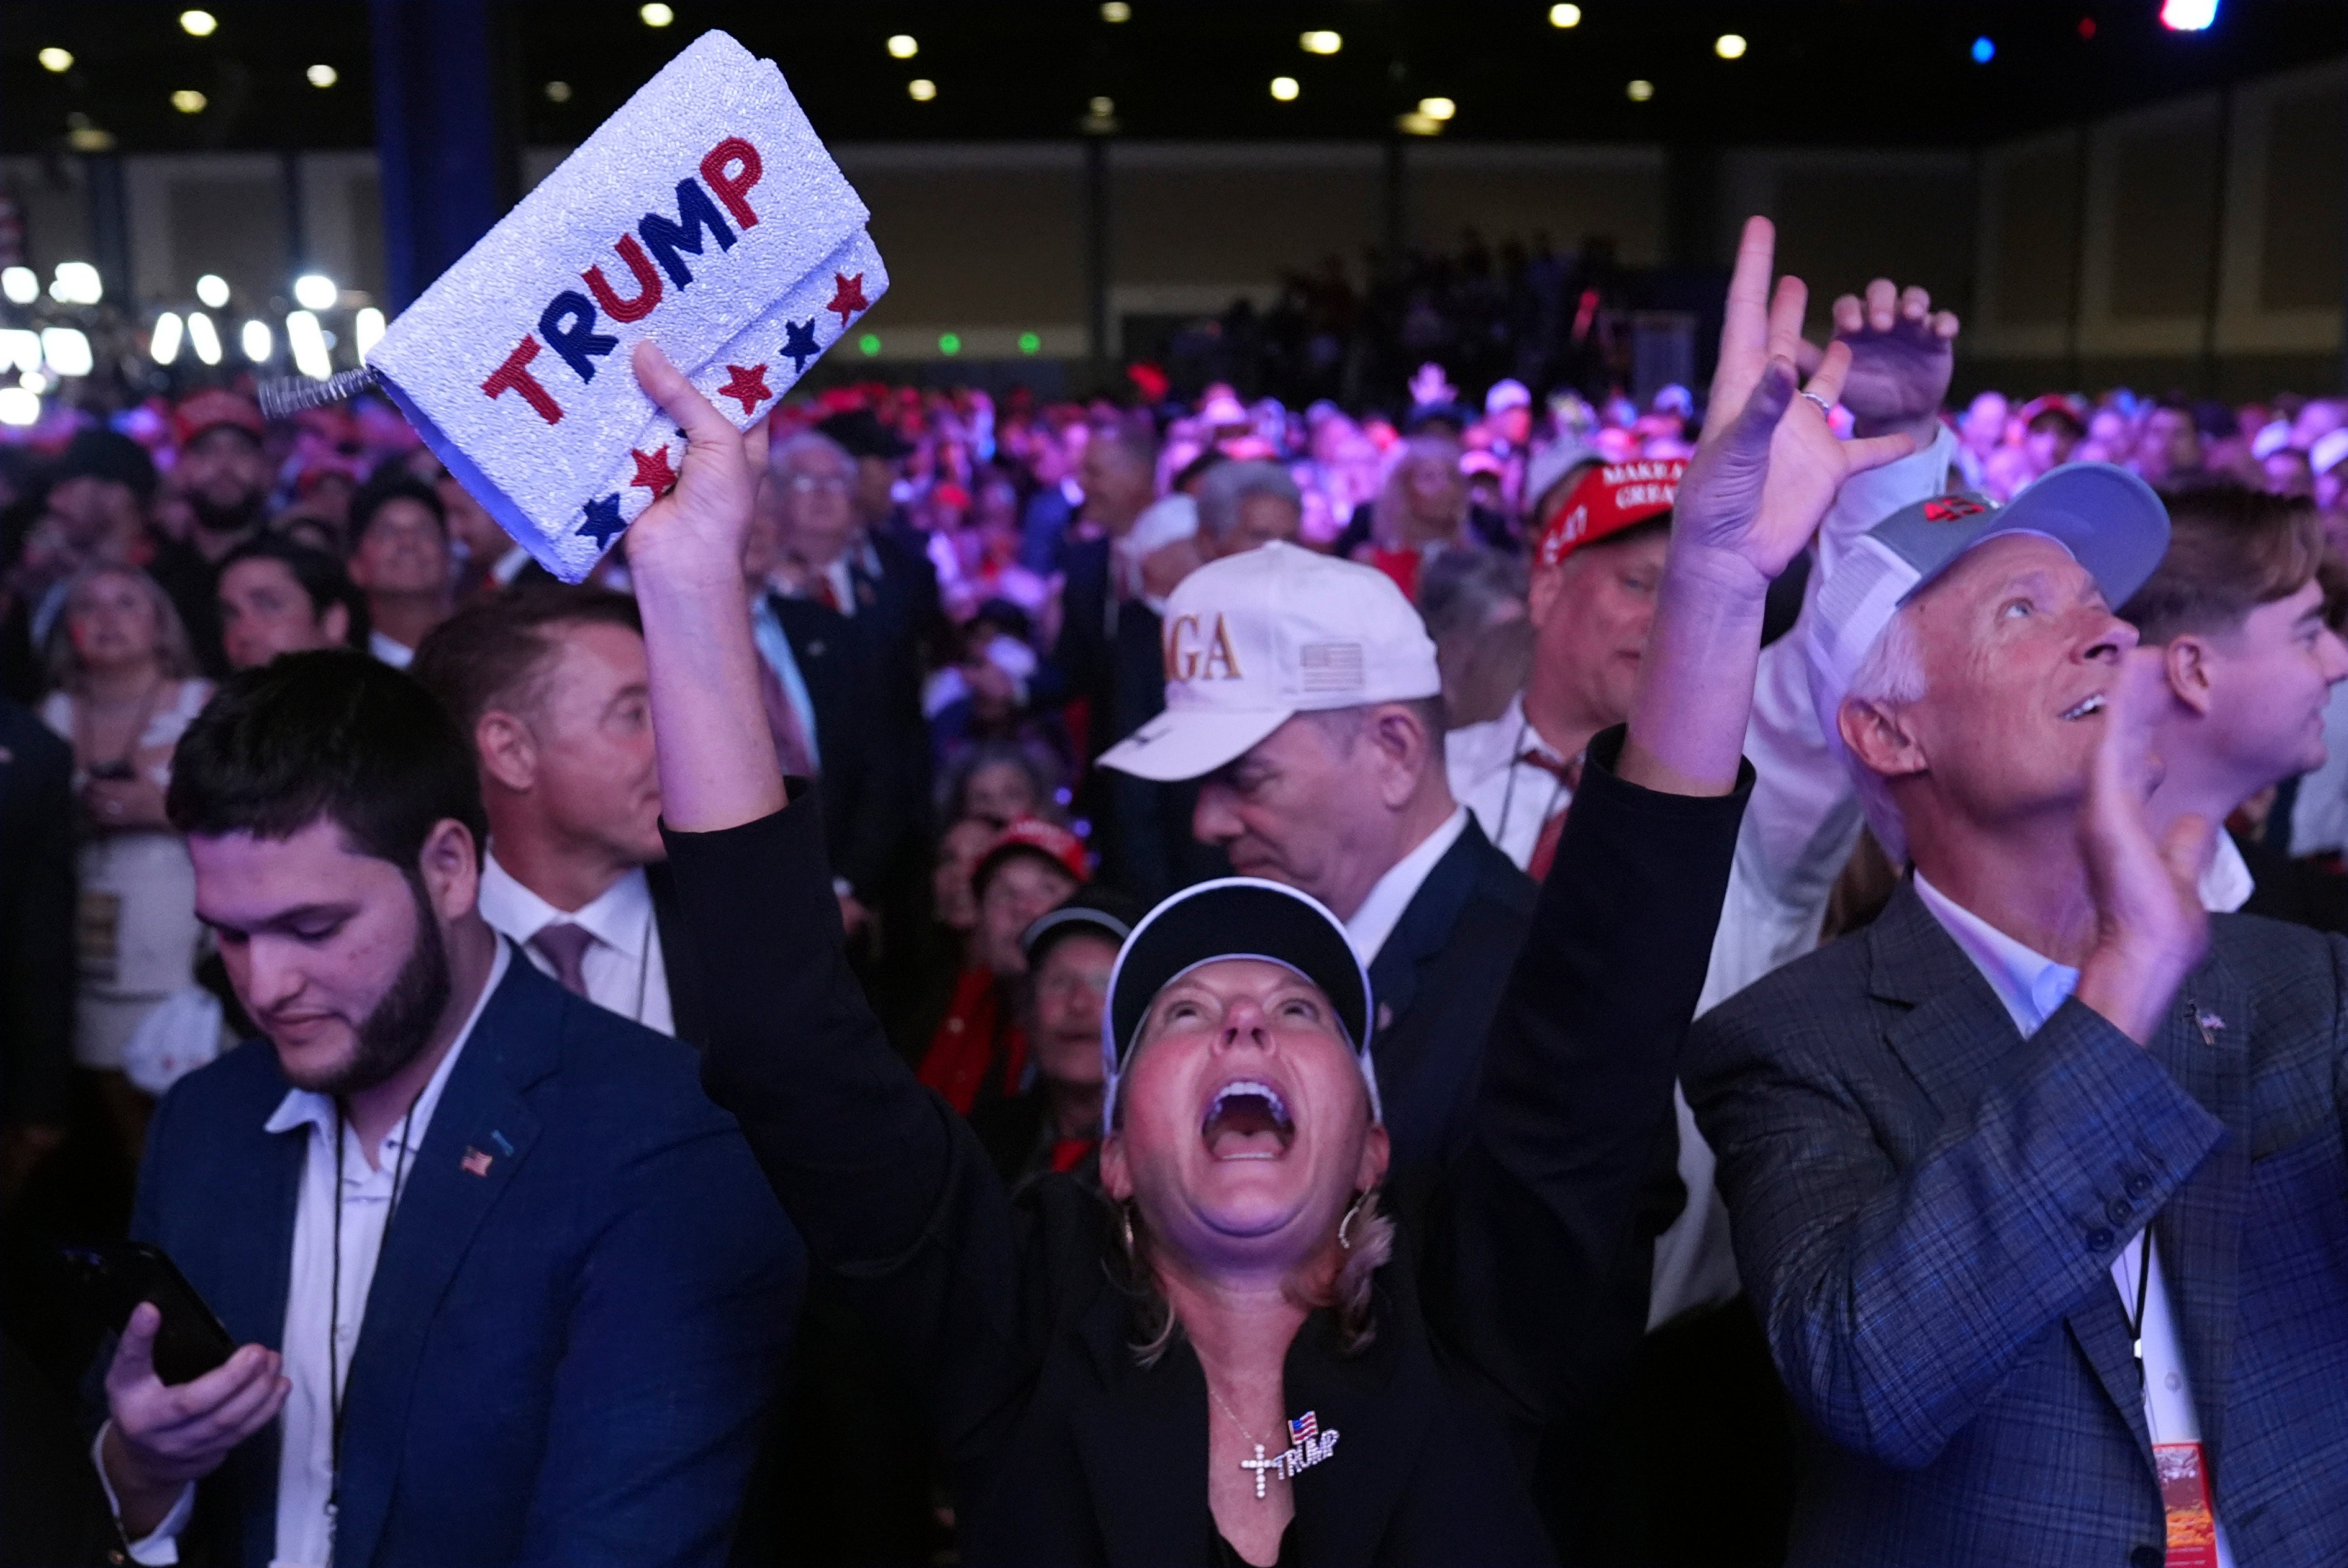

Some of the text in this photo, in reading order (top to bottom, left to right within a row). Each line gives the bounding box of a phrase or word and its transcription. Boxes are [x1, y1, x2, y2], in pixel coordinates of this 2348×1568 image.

[481, 137, 762, 425] TRUMP
[1603, 462, 1667, 486] MAKE
[1616, 483, 1675, 509] GREA
[1161, 612, 1242, 680] GA
[1273, 1429, 1340, 1480] TRUMP
